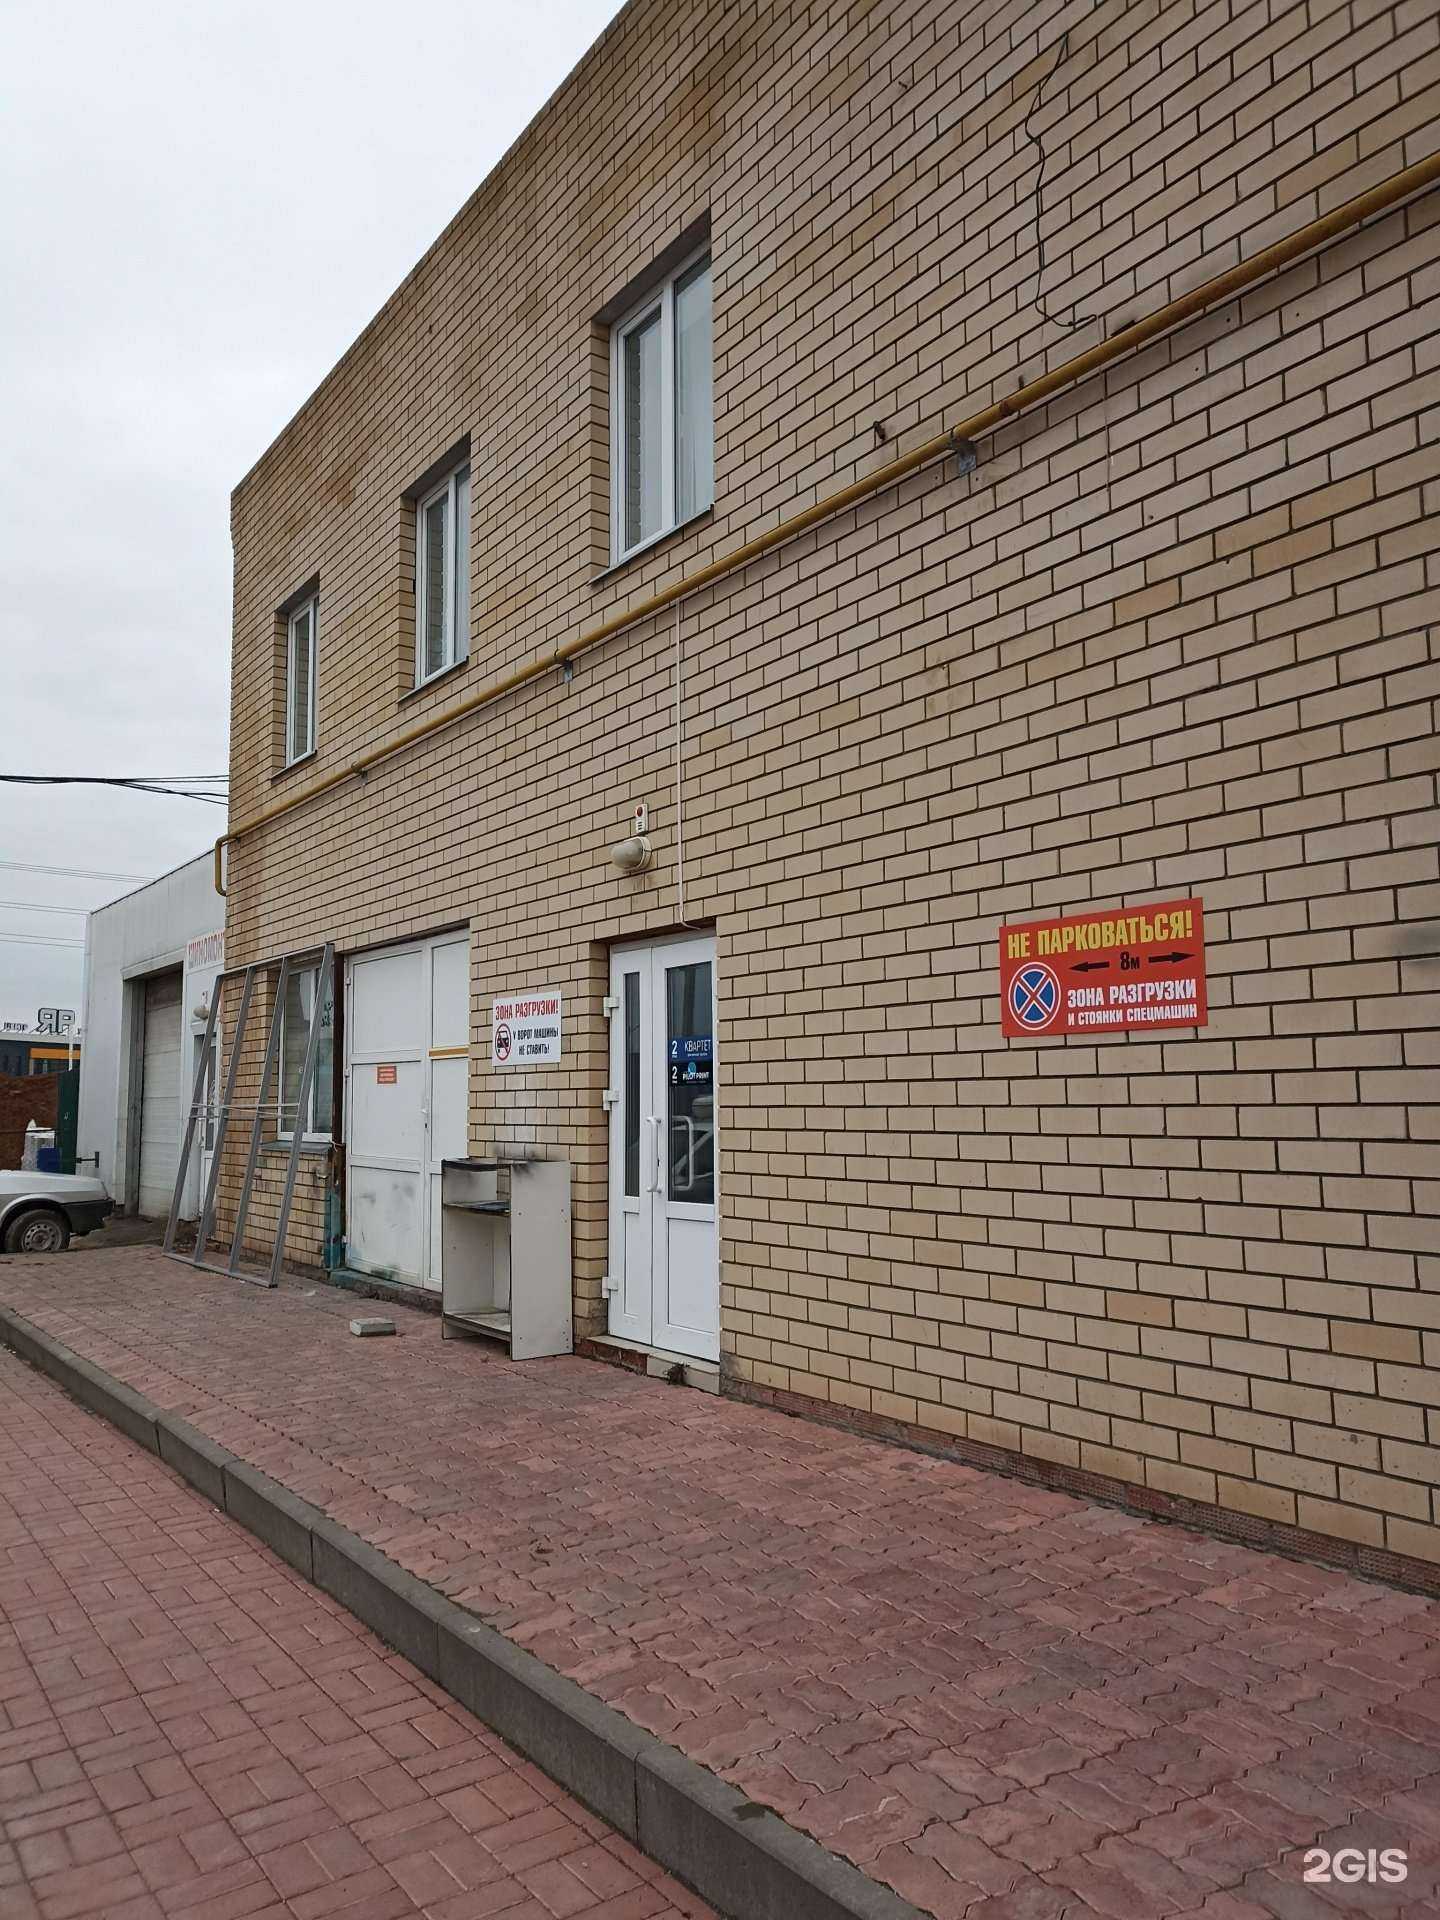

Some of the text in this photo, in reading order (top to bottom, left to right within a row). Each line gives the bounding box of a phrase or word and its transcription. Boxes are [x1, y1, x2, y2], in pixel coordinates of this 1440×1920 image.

[1007, 910, 1193, 959] НЕ ПАРКОВАТЬСЯ!
[1067, 978, 1197, 1008] ЗОНА РАЗГРУЗКИ
[495, 999, 559, 1021] ЗОНА РАЗГРУЗКИ!
[1067, 1003, 1198, 1026] И СТОЯНКИ СПЕЦМАШИН
[513, 1026, 559, 1041] У ВОРОТ МАШИНЫ
[518, 1043, 550, 1056] НЕ СТАВИТЬ!
[671, 1039, 711, 1055] 2 КВАРТЕТ
[671, 1065, 678, 1080] 2
